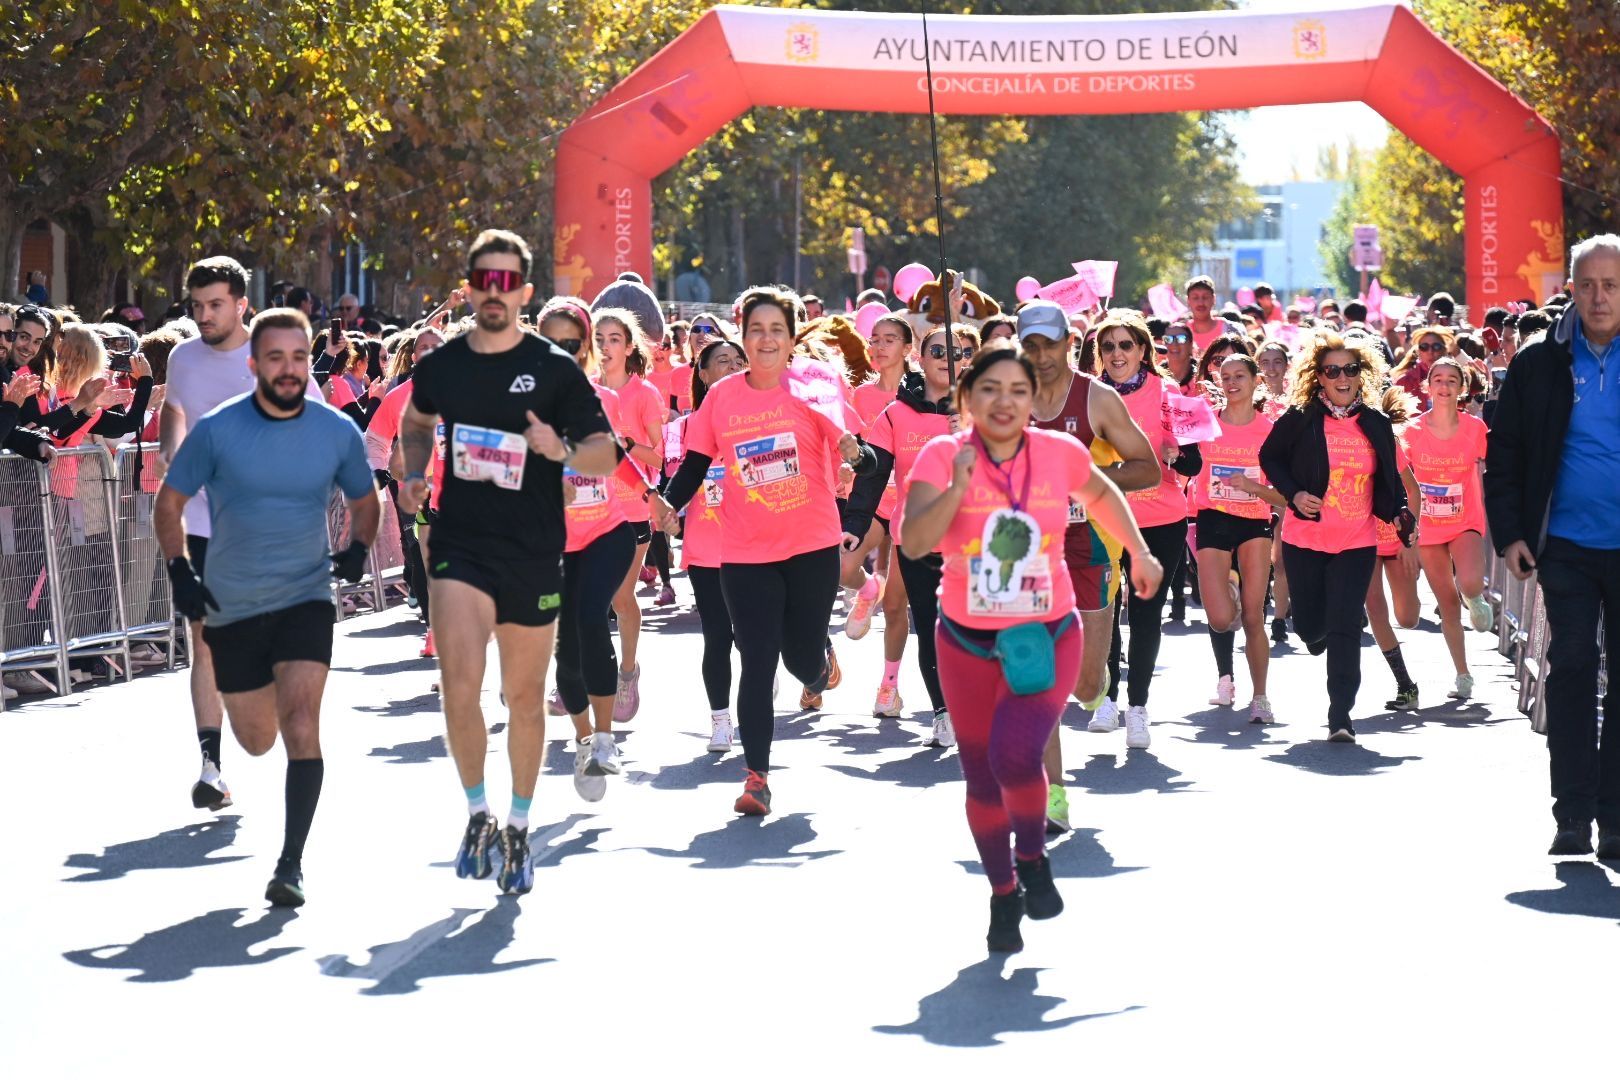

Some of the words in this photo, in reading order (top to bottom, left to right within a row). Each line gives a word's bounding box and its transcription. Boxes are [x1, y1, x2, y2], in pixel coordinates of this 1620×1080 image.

[873, 38, 1106, 62] AYUNTAMIENTO
[1116, 38, 1152, 60] DE
[1163, 30, 1238, 59] LEÓN
[917, 73, 1046, 95] CONCEJALÍA
[1053, 76, 1081, 93] DE
[1088, 73, 1196, 92] DEPORTES
[614, 187, 632, 278] EPORTES
[1480, 185, 1498, 294] DEPORTES
[729, 405, 783, 428] Drasanvi
[477, 447, 511, 464] 4763
[752, 447, 797, 465] MADRINA
[1432, 496, 1455, 505] 3783
